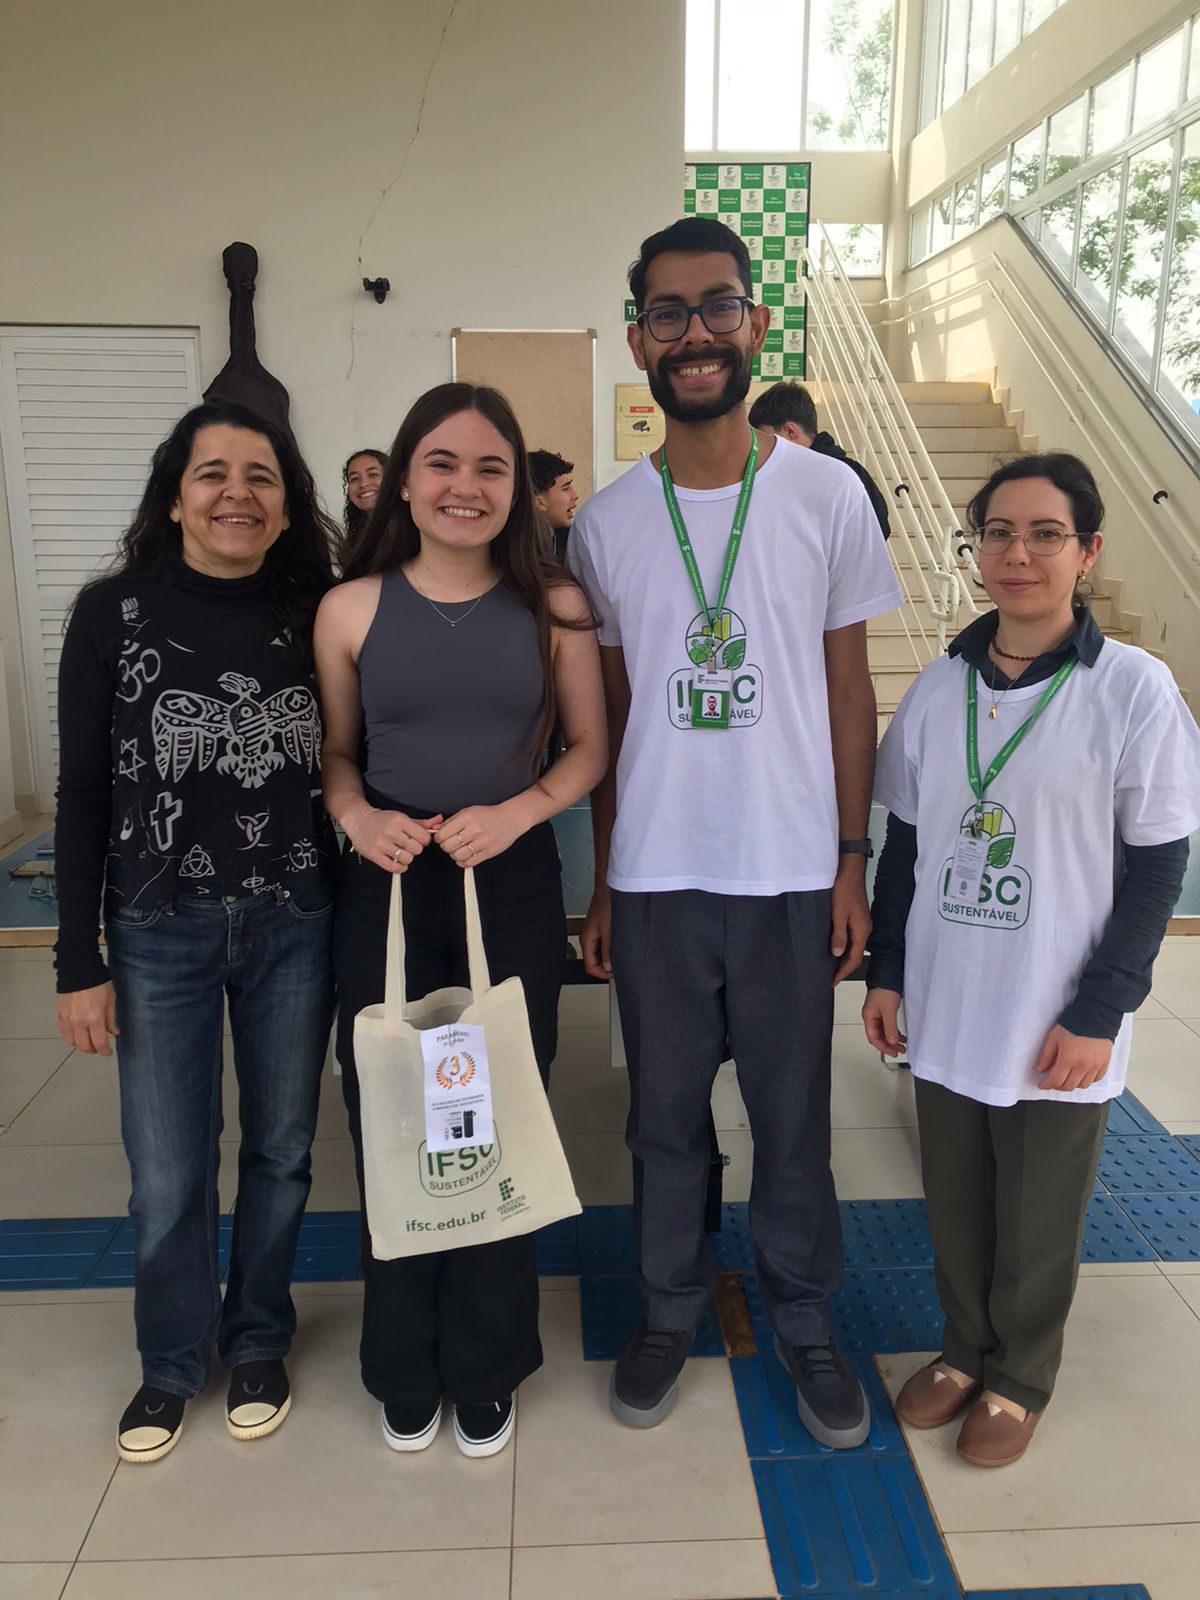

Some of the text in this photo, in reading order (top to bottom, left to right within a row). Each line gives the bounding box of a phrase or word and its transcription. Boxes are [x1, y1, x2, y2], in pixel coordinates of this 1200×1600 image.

[677, 675, 756, 709] IC
[678, 709, 756, 723] SUÁVEL
[943, 867, 1022, 906] ISC
[942, 902, 1020, 922] SUSTENTÁVEL
[450, 1056, 461, 1076] 3
[429, 1156, 498, 1191] SUSTENTÁVEL
[497, 1194, 526, 1212] INSTITUTO
[500, 1202, 525, 1216] FEDERAL
[406, 1210, 486, 1232] ifsc.edu.br
